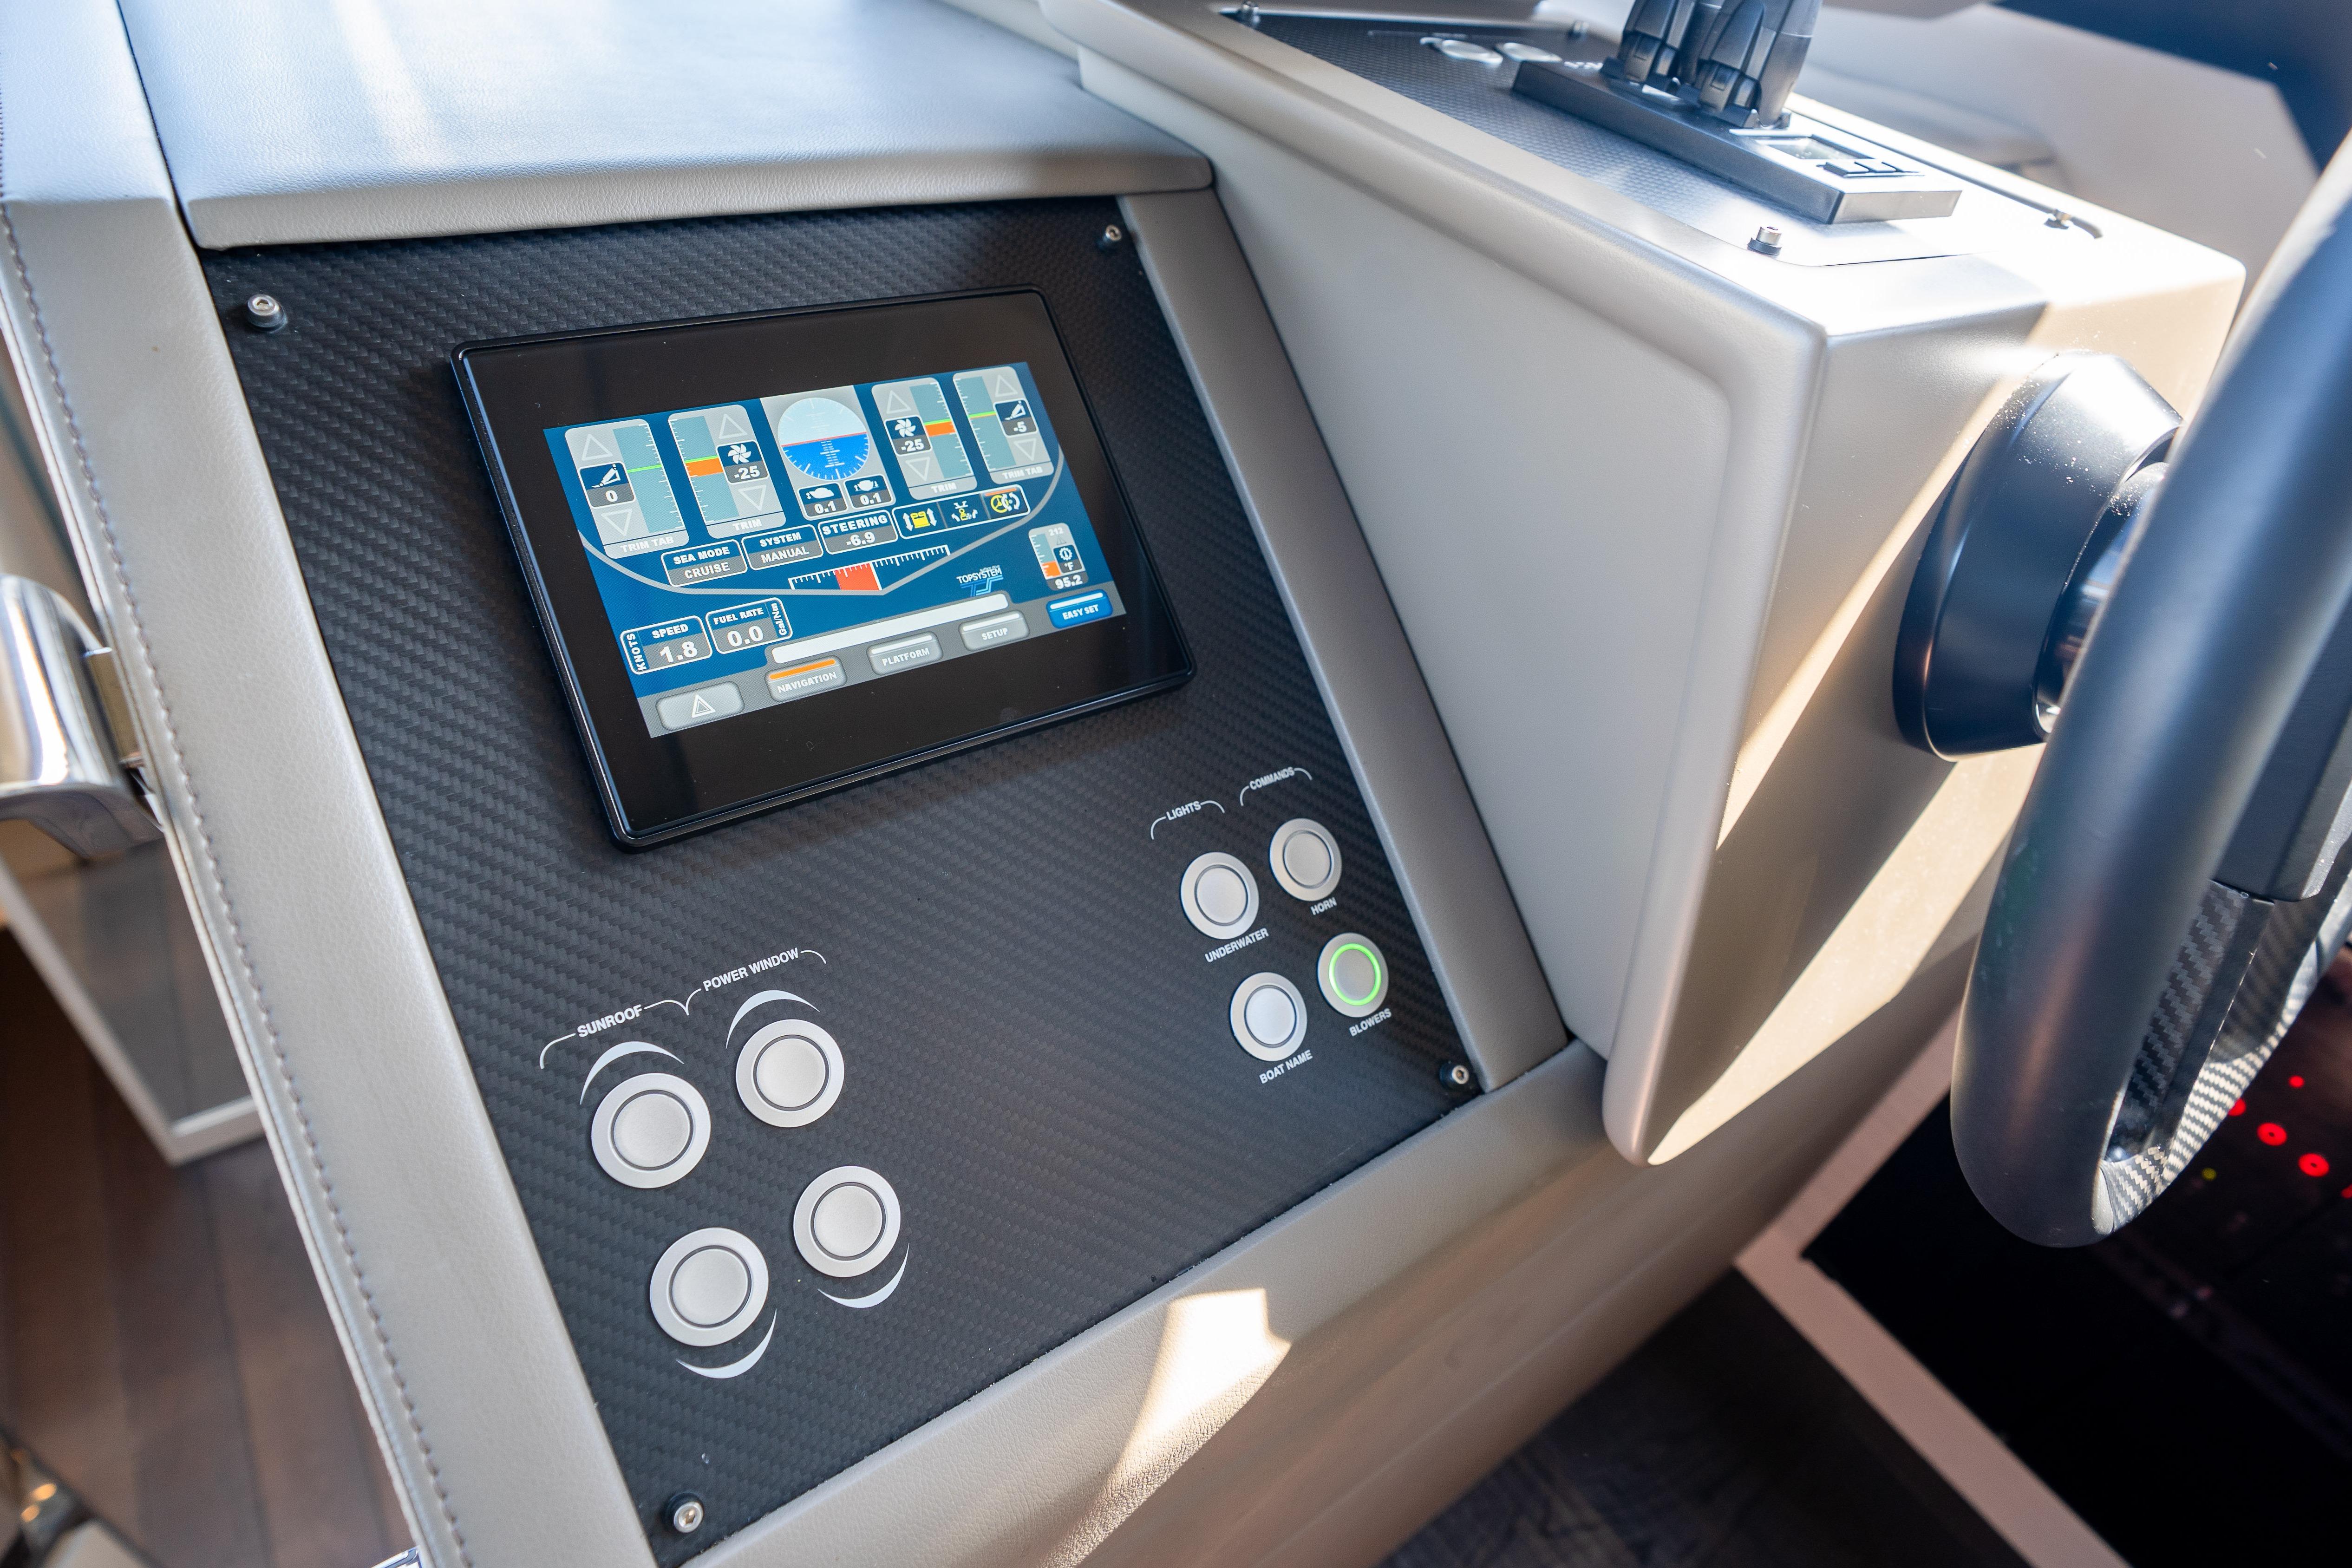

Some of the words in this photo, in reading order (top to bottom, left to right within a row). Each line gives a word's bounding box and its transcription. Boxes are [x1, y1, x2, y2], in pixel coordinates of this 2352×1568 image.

[1013, 422, 1027, 433] -5
[901, 439, 924, 451] -25
[734, 465, 761, 479] -25
[1002, 469, 1024, 480] TRIM
[1025, 466, 1043, 476] TAB
[605, 490, 618, 503] 0
[931, 483, 956, 494] TRIM
[814, 501, 837, 514] 0.1
[860, 494, 882, 505] 0.1
[733, 519, 762, 530] TRIM
[823, 515, 888, 535] STEERING
[1049, 528, 1064, 536] 212
[621, 540, 649, 553] TRIM
[651, 536, 674, 547] TAB
[759, 532, 802, 547] SYSTEM
[846, 532, 875, 546] -6.9
[673, 554, 696, 565] SEA
[699, 547, 730, 561] MODE
[761, 547, 810, 563] MANUAL
[684, 562, 731, 580] CRUISE
[956, 568, 1002, 583] TOPSYSTEM
[1055, 575, 1083, 589] 95.2
[713, 613, 738, 625] FUEL
[740, 607, 764, 619] RATE
[771, 603, 787, 635] Gal/Nm
[1063, 608, 1083, 620] EASY
[1084, 604, 1099, 614] SET
[652, 624, 688, 639] SPEED
[727, 626, 764, 647] 0.0
[981, 627, 1007, 640] SETUP
[627, 633, 647, 671] KNOTS
[660, 641, 698, 663] 1.8
[882, 647, 930, 666] PLATFORM
[777, 672, 837, 693] NAVIGATION
[1249, 766, 1295, 790] COMMANDS
[1166, 801, 1202, 821] LIGHTS
[1311, 897, 1337, 915] HORN
[1205, 928, 1269, 962] UNDERWATER
[703, 967, 748, 992] POWER
[748, 947, 799, 974] WINDOW
[577, 1005, 643, 1038] SUNROOF
[1349, 1008, 1392, 1037] BLOWERS
[1259, 1064, 1285, 1084] BOAT
[1285, 1050, 1313, 1070] NAME
